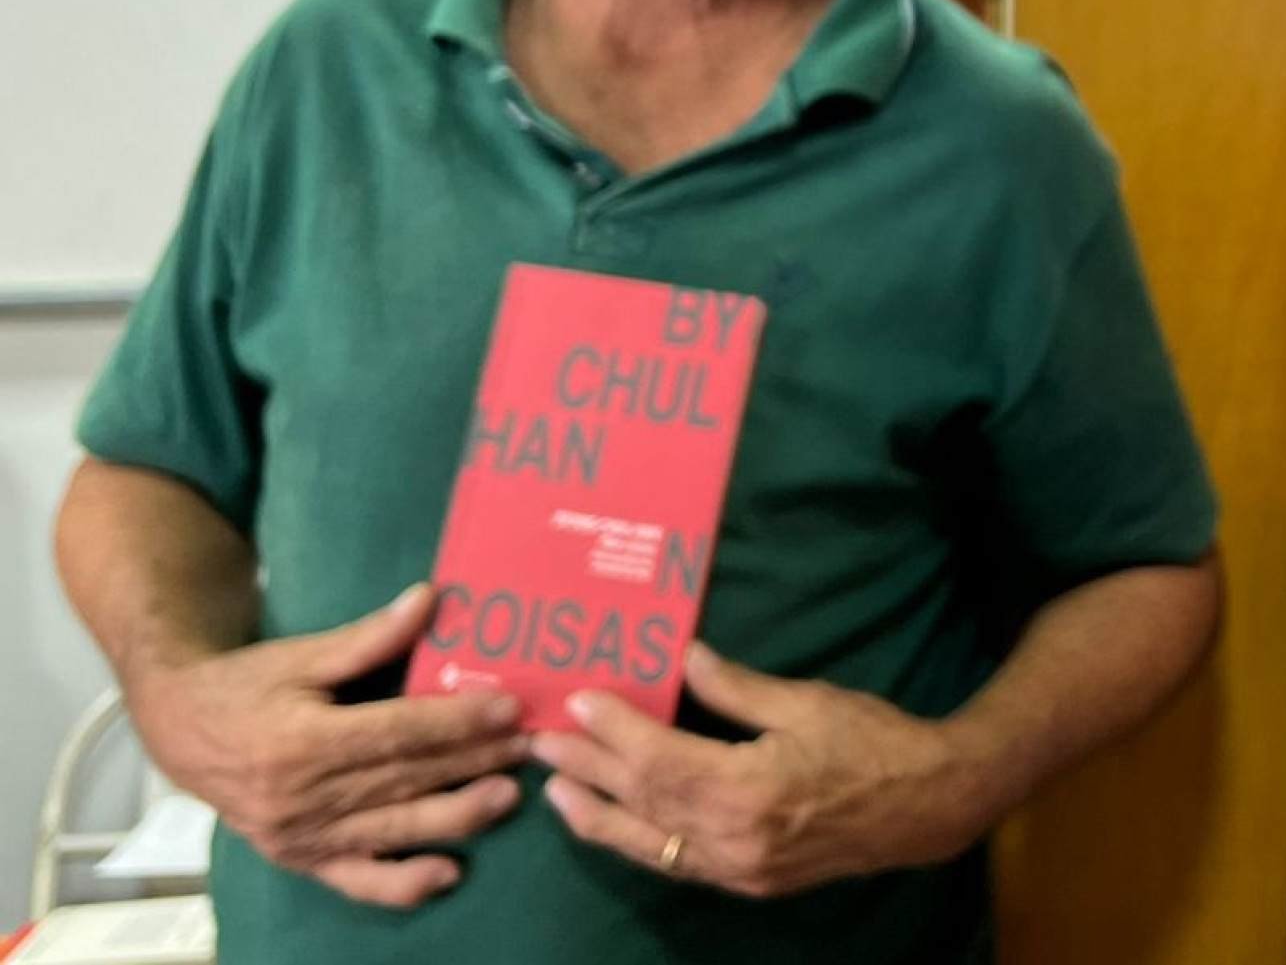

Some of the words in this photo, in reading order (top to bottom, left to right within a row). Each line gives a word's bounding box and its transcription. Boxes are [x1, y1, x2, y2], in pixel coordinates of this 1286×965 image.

[664, 284, 748, 350] BY
[557, 343, 721, 429] CHUL
[426, 581, 677, 688] COISAS
